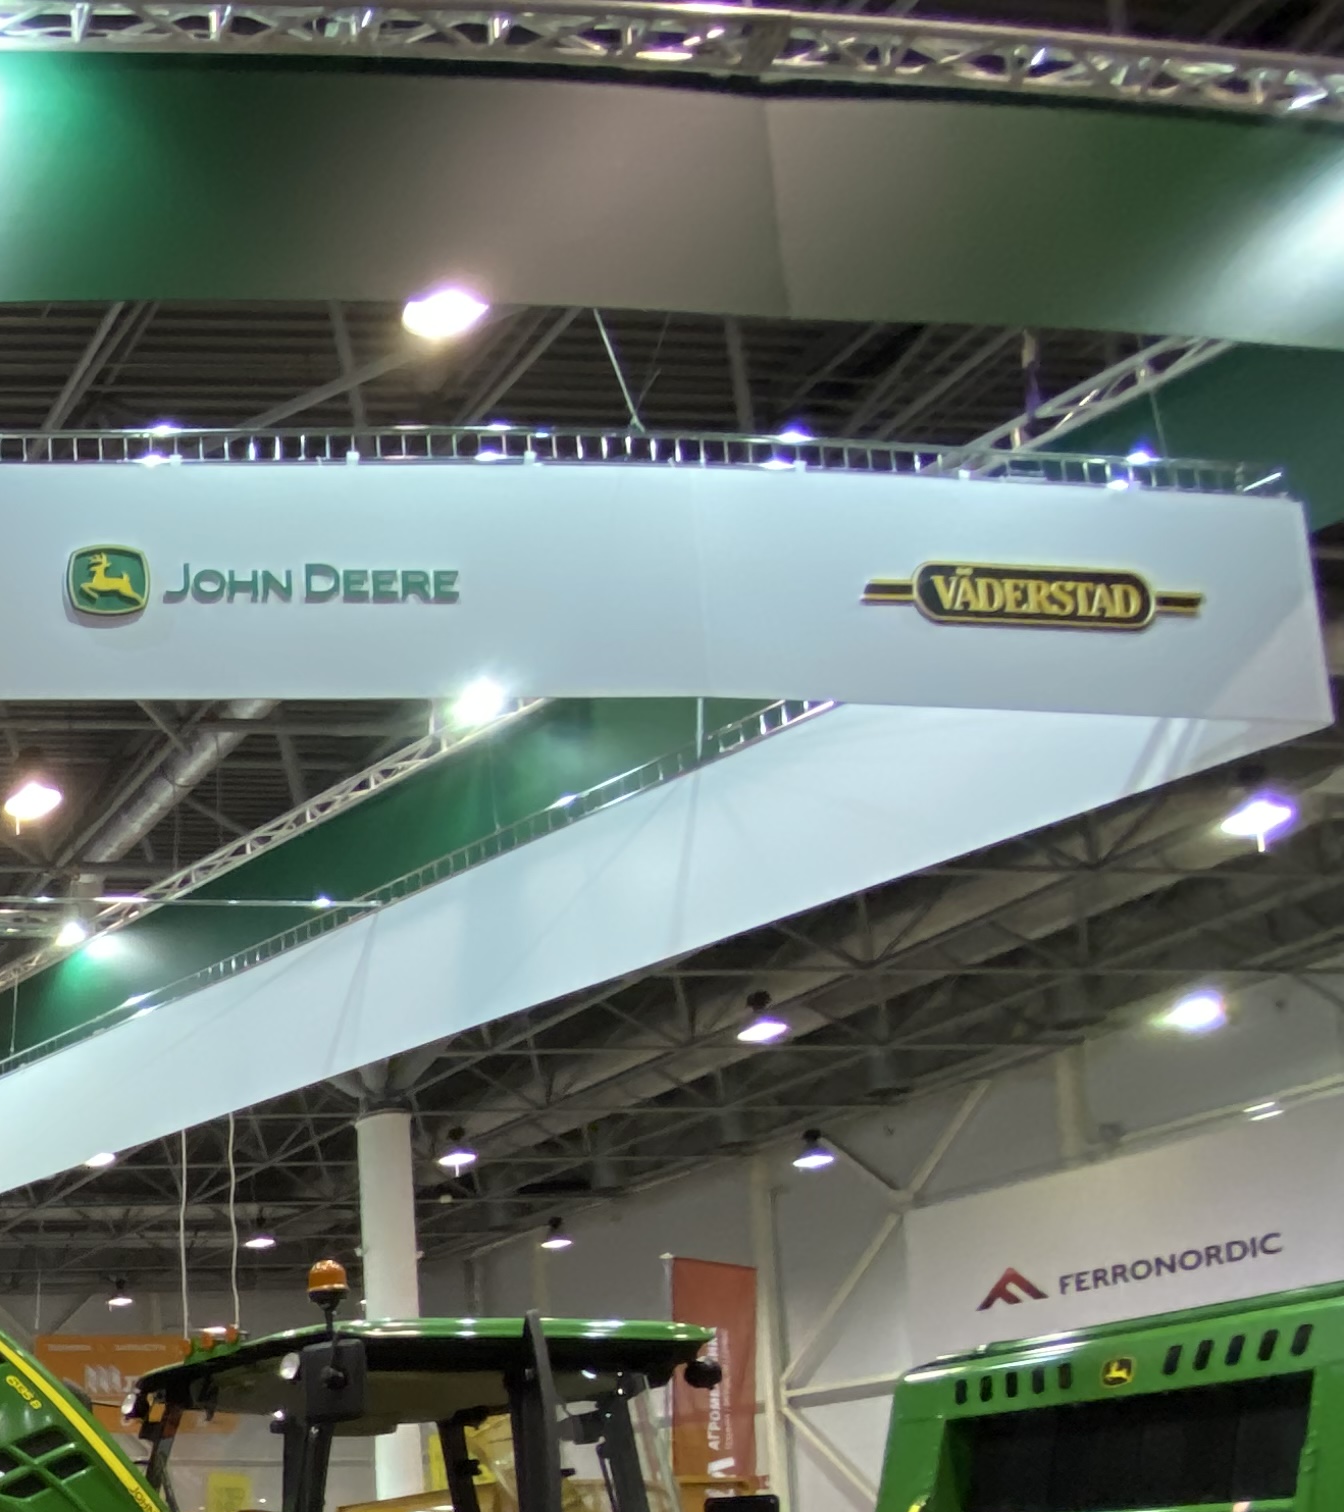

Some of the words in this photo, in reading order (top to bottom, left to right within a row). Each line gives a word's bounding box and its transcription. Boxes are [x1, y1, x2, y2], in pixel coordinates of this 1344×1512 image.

[164, 563, 292, 603] JOHN
[305, 563, 460, 603] DEERE
[931, 567, 1142, 618] VÄDERSTAD
[1059, 1233, 1284, 1295] FERRONORDIC
